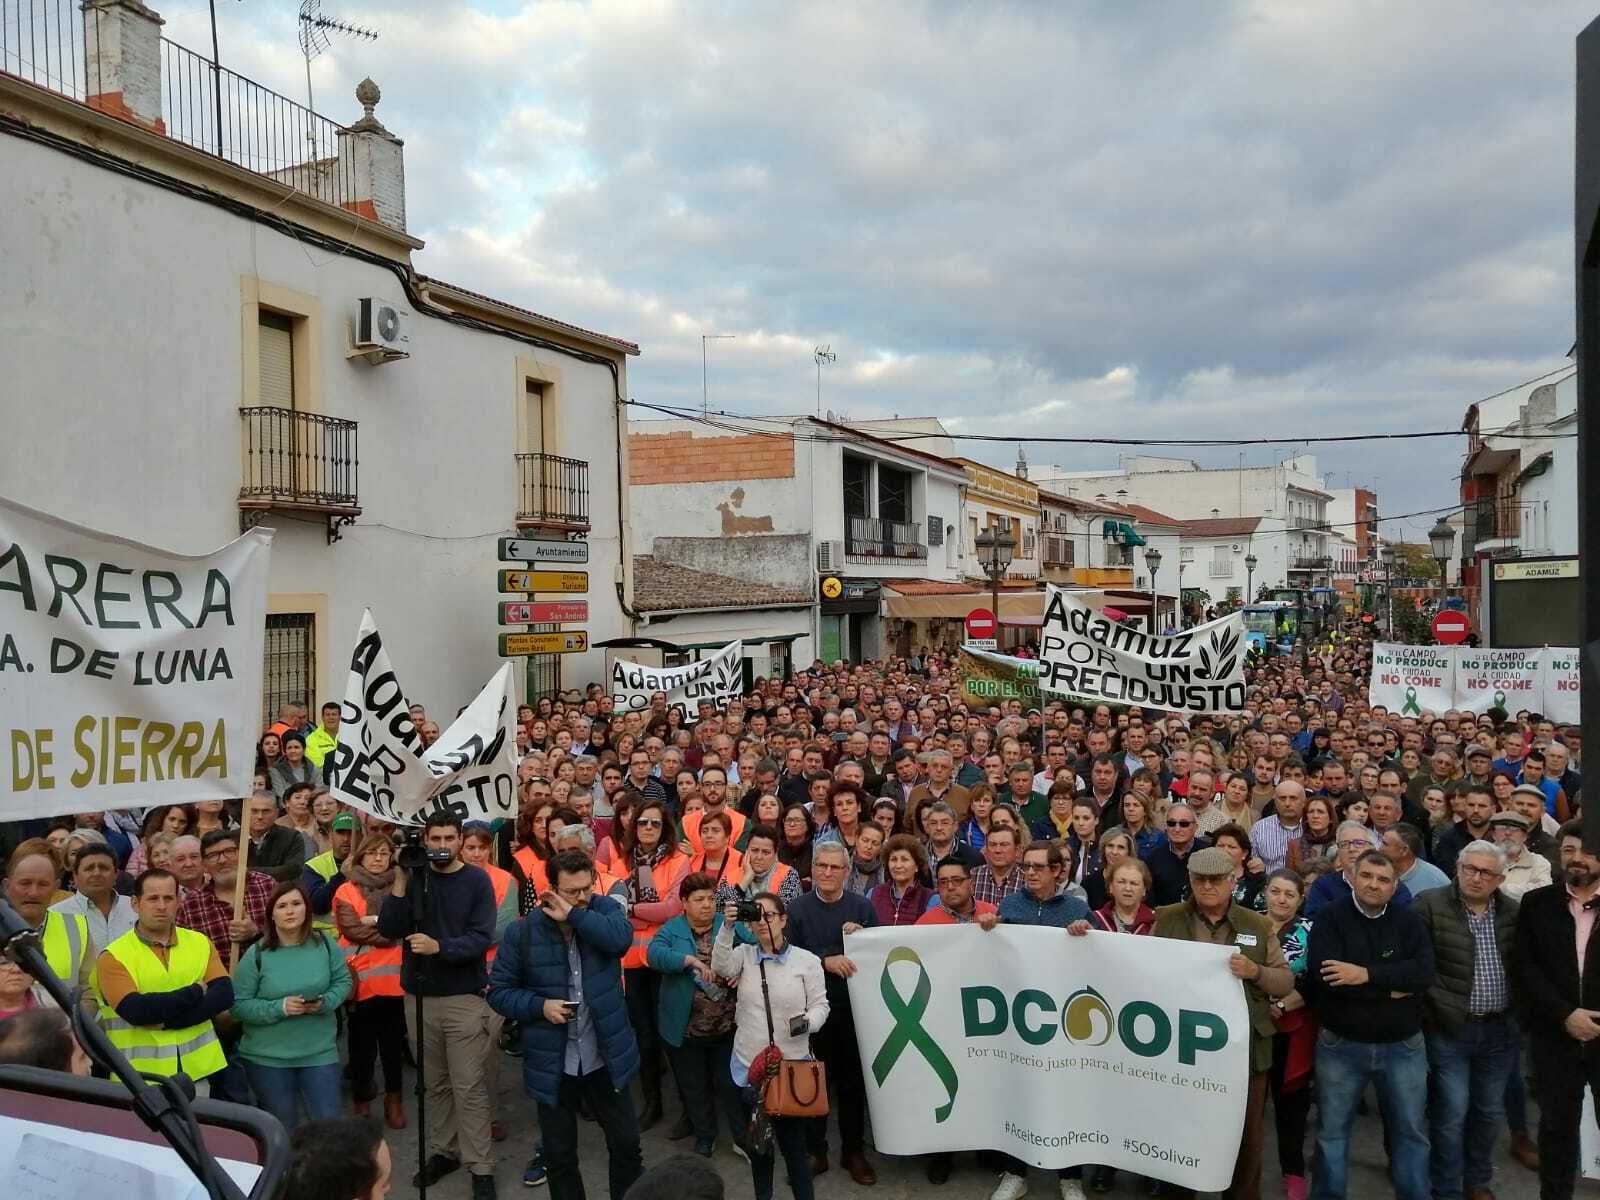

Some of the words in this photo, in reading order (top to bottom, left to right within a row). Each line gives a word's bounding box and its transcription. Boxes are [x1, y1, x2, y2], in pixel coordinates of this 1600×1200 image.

[535, 546, 586, 557] Ayuntamiento
[1525, 568, 1560, 577] ADAMUZ
[561, 581, 586, 590] Turismo
[1042, 591, 1194, 659] Adamuz
[1043, 635, 1119, 673] POR
[1145, 662, 1191, 684] UN
[1402, 648, 1437, 659] CAMPO
[1490, 651, 1526, 661] CAMPO
[50, 637, 119, 680] DE
[133, 647, 234, 685] LUNA
[1376, 655, 1393, 664] NO
[1395, 657, 1449, 669] PRODUCE
[1462, 660, 1480, 670] NO
[1483, 661, 1539, 670] PRODUCE
[1552, 660, 1571, 670] NO
[612, 659, 712, 690] Adamuz
[1402, 668, 1431, 677] CIUDAD
[1490, 671, 1521, 680] CIUDAD
[967, 679, 998, 697] POR
[1001, 680, 1018, 697] EL
[1380, 674, 1400, 685] NO
[1404, 676, 1442, 688] COME
[1467, 679, 1489, 689] NO
[1492, 680, 1533, 690] COME
[1557, 680, 1580, 691] NO
[684, 681, 716, 699] UN
[10, 728, 55, 792] DE
[70, 715, 228, 789] SIERRA
[960, 984, 1230, 1066] DCOOP
[967, 1046, 990, 1059] Por
[992, 1048, 1008, 1060] un
[1009, 1051, 1044, 1069] precio
[1046, 1056, 1077, 1072] justo
[1080, 1057, 1110, 1071] para
[1112, 1061, 1124, 1074] el
[1127, 1066, 1168, 1082] aceite
[1170, 1073, 1189, 1087] de
[1192, 1077, 1228, 1094] oliva
[1004, 1120, 1109, 1148] #AceiteconPrecio
[1123, 1137, 1201, 1169] #SOSolivar
